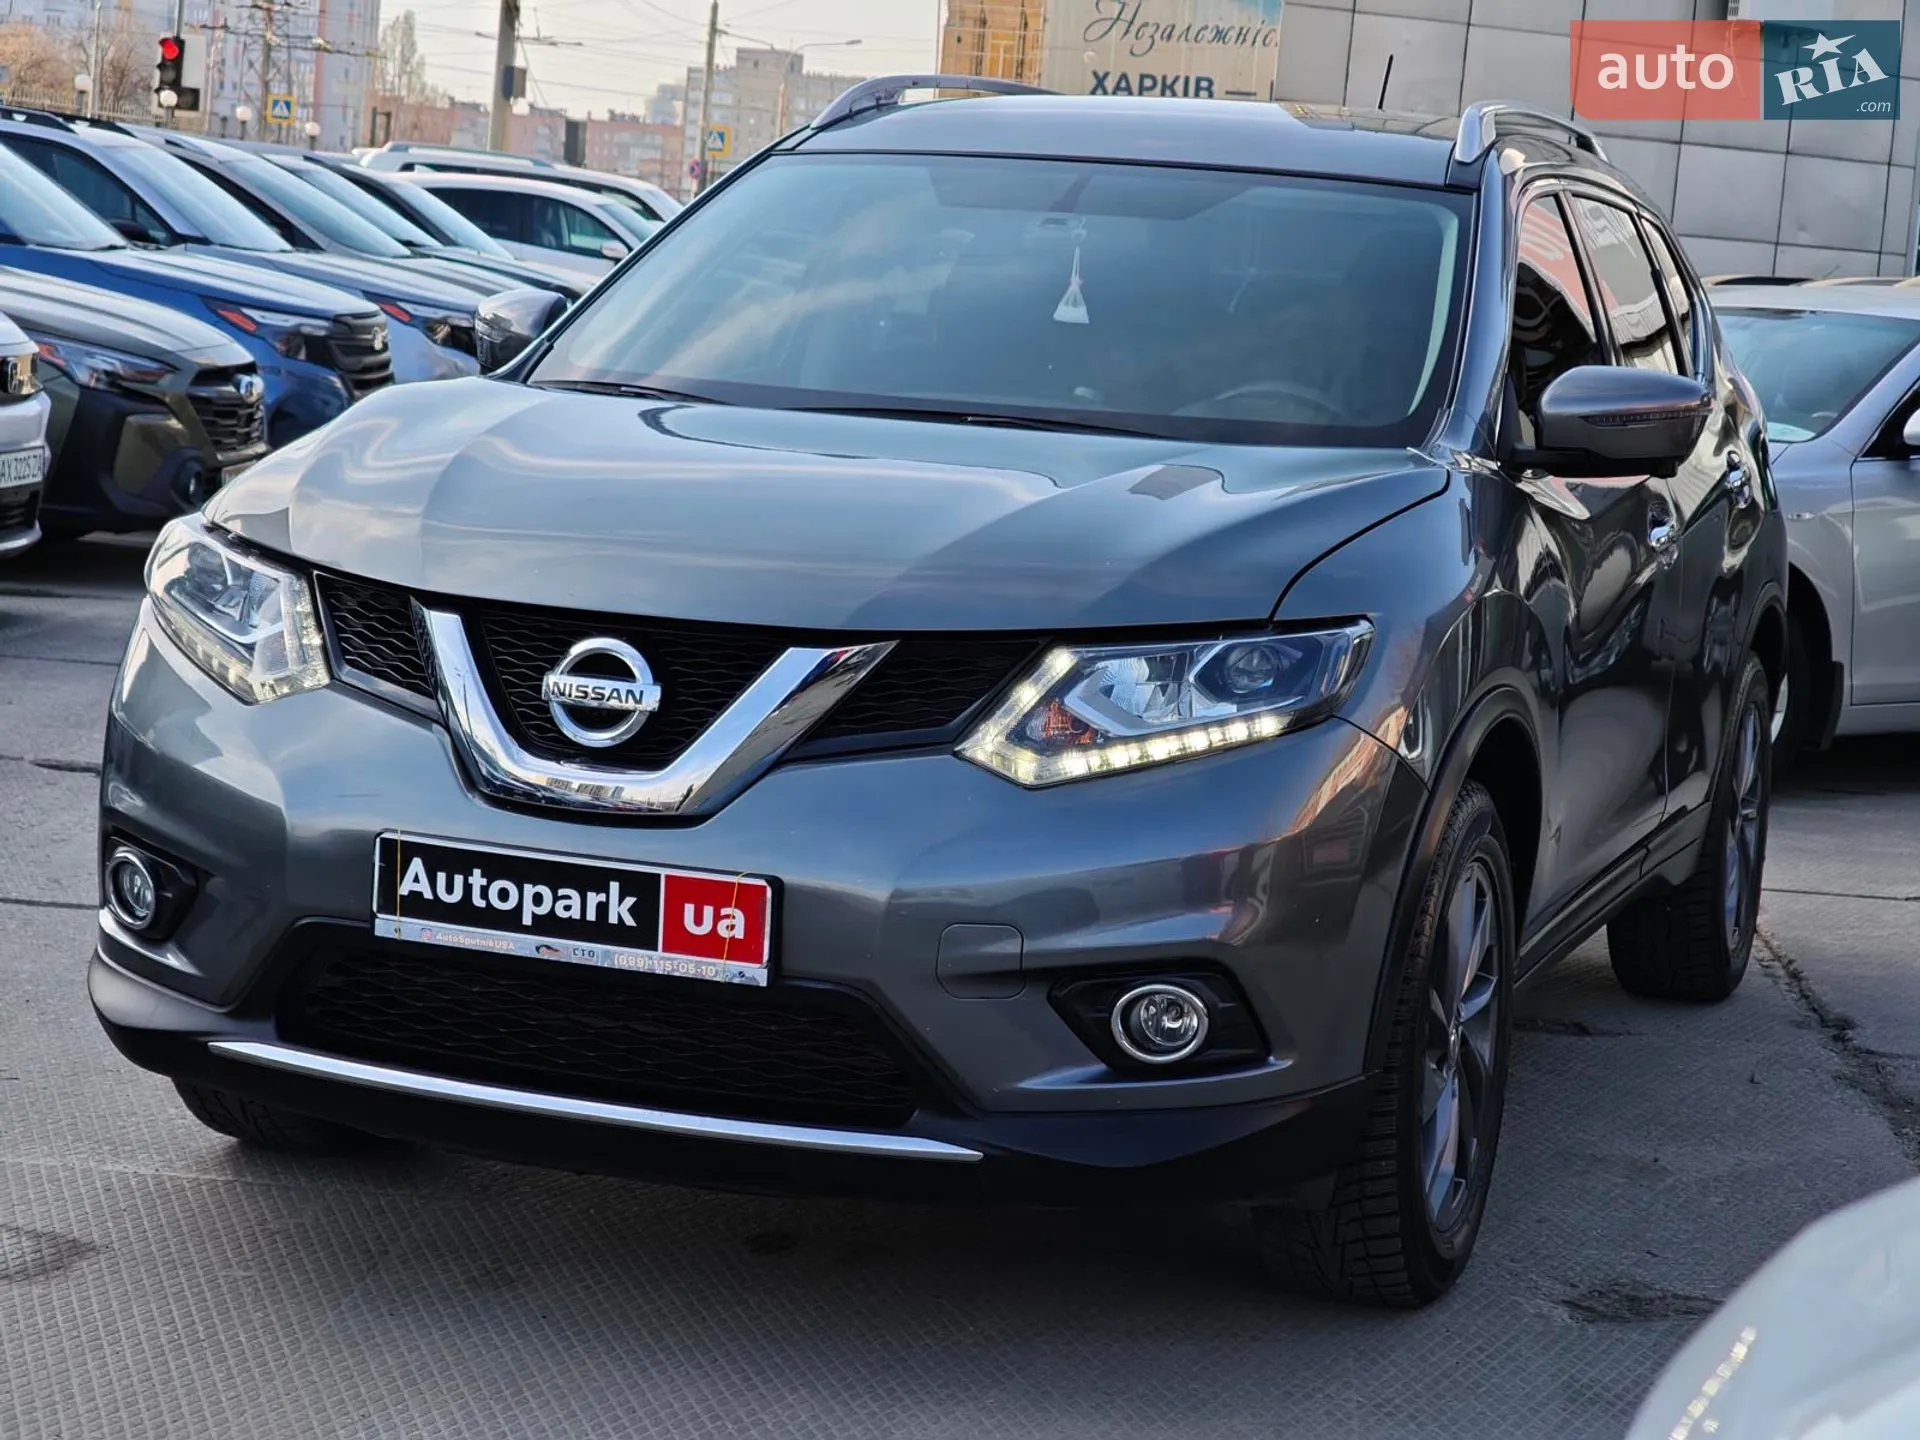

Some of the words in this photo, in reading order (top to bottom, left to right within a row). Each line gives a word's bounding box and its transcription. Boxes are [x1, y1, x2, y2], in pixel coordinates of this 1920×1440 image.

[1083, 0, 1278, 57] Незалежніс
[1089, 70, 1216, 99] ХАРКІВ
[550, 681, 645, 705] NISSAN
[399, 857, 638, 927] Autopark
[683, 902, 745, 940] ua
[435, 931, 516, 950] AutoSputnikUSA
[572, 947, 596, 959] СТО
